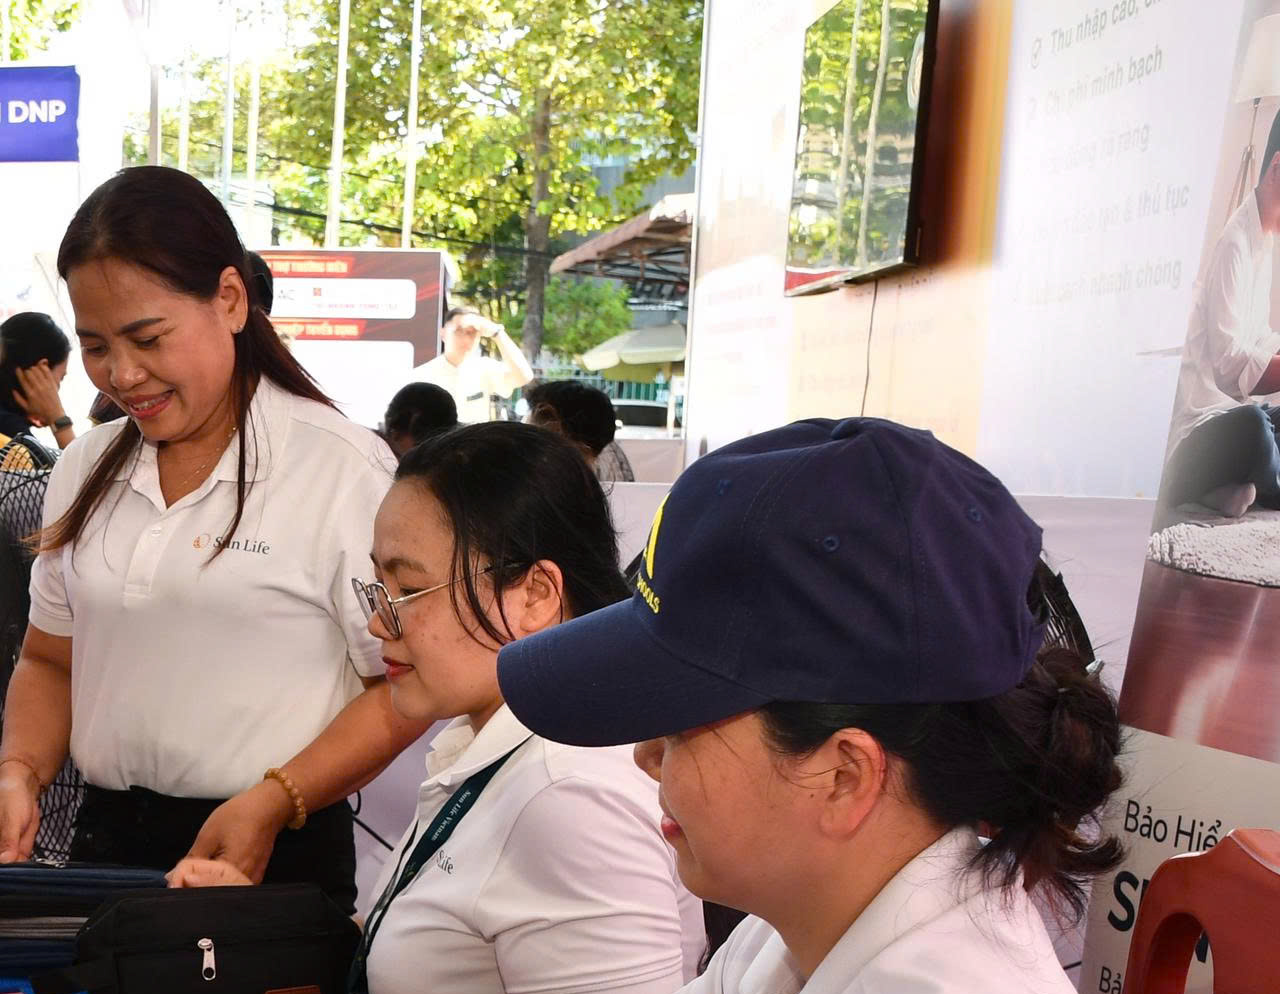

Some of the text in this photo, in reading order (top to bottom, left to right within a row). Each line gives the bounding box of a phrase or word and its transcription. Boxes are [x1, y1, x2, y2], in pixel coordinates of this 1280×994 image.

[1051, 28, 1072, 55] Thu
[1128, 45, 1163, 84] bạch
[8, 100, 67, 123] DNP
[243, 539, 270, 554] Life
[1124, 799, 1168, 842] Bảo
